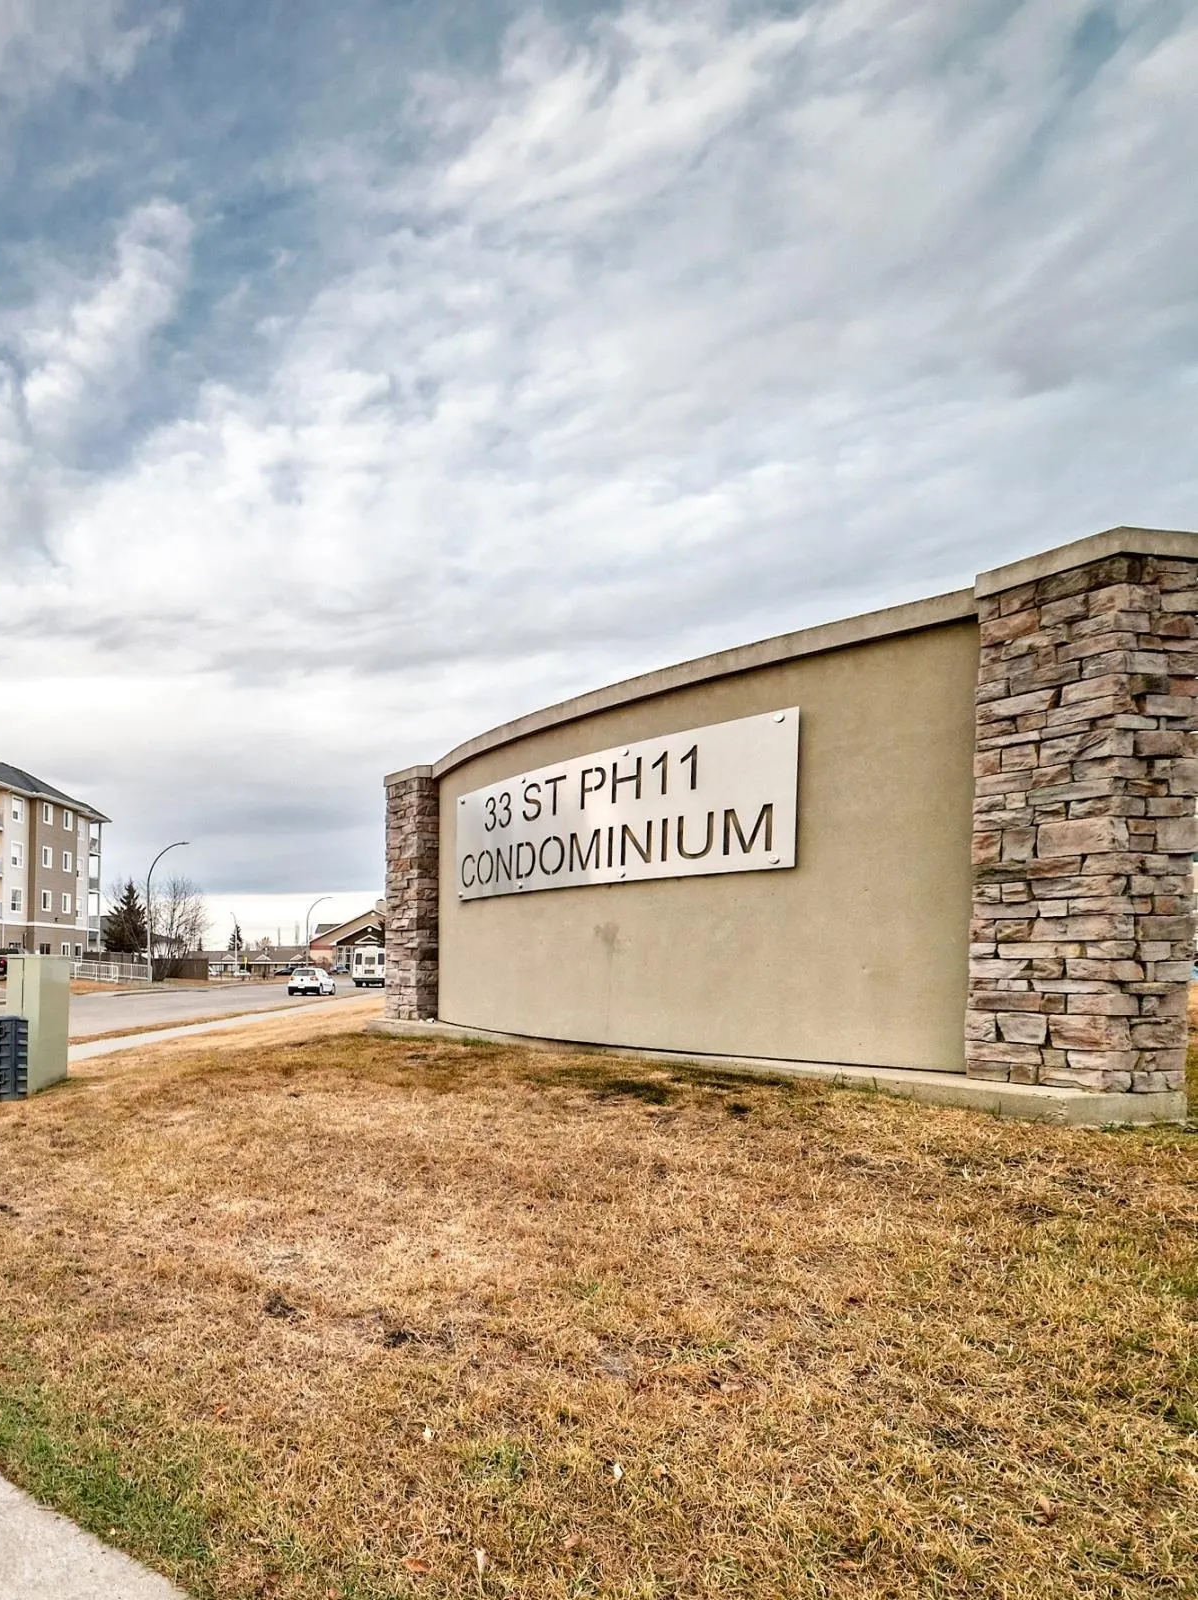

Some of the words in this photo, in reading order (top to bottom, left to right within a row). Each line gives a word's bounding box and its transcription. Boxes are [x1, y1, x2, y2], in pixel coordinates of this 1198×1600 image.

[484, 791, 512, 832] 33
[522, 774, 567, 822] ST
[580, 744, 699, 810] PH11
[461, 802, 774, 888] CONDOMINIUM
